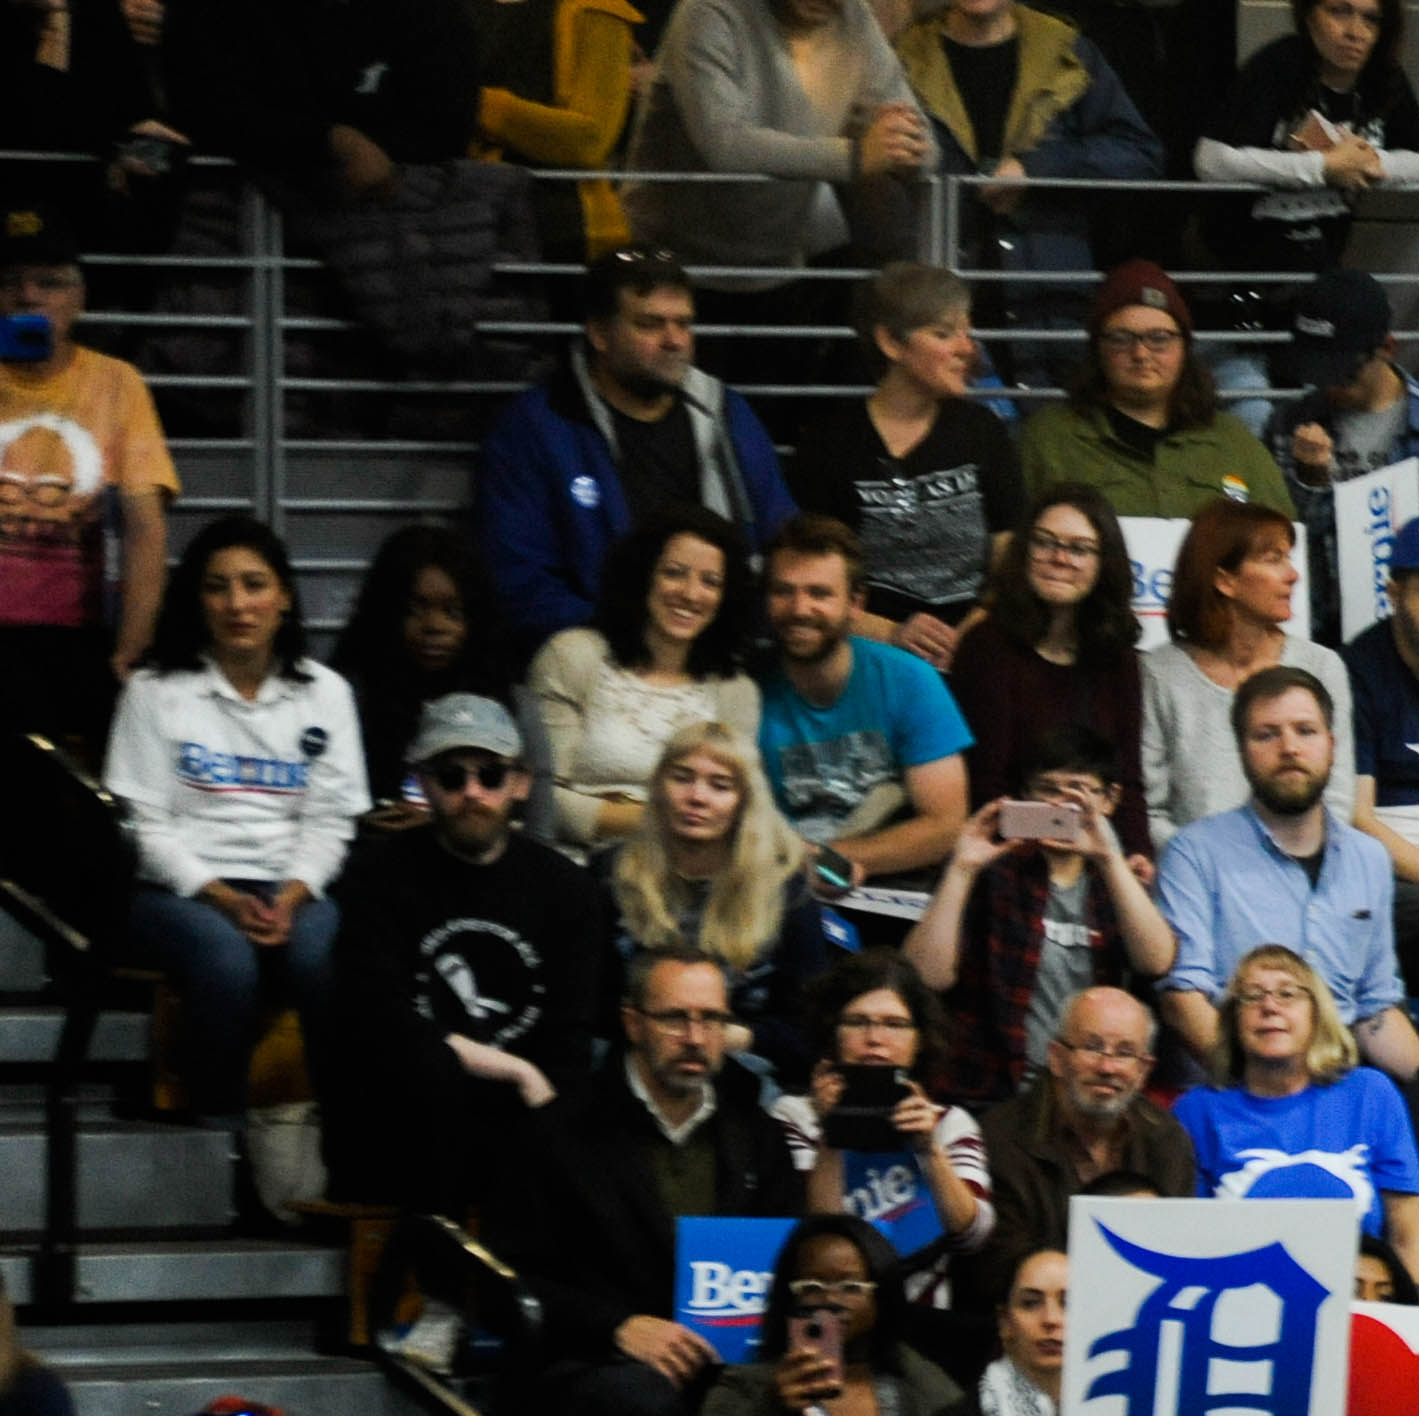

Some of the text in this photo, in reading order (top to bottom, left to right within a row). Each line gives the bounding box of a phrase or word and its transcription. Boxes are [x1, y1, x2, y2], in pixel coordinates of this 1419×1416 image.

[1367, 484, 1386, 619] ernie
[848, 1167, 911, 1216] nie
[688, 1260, 780, 1310] Ber
